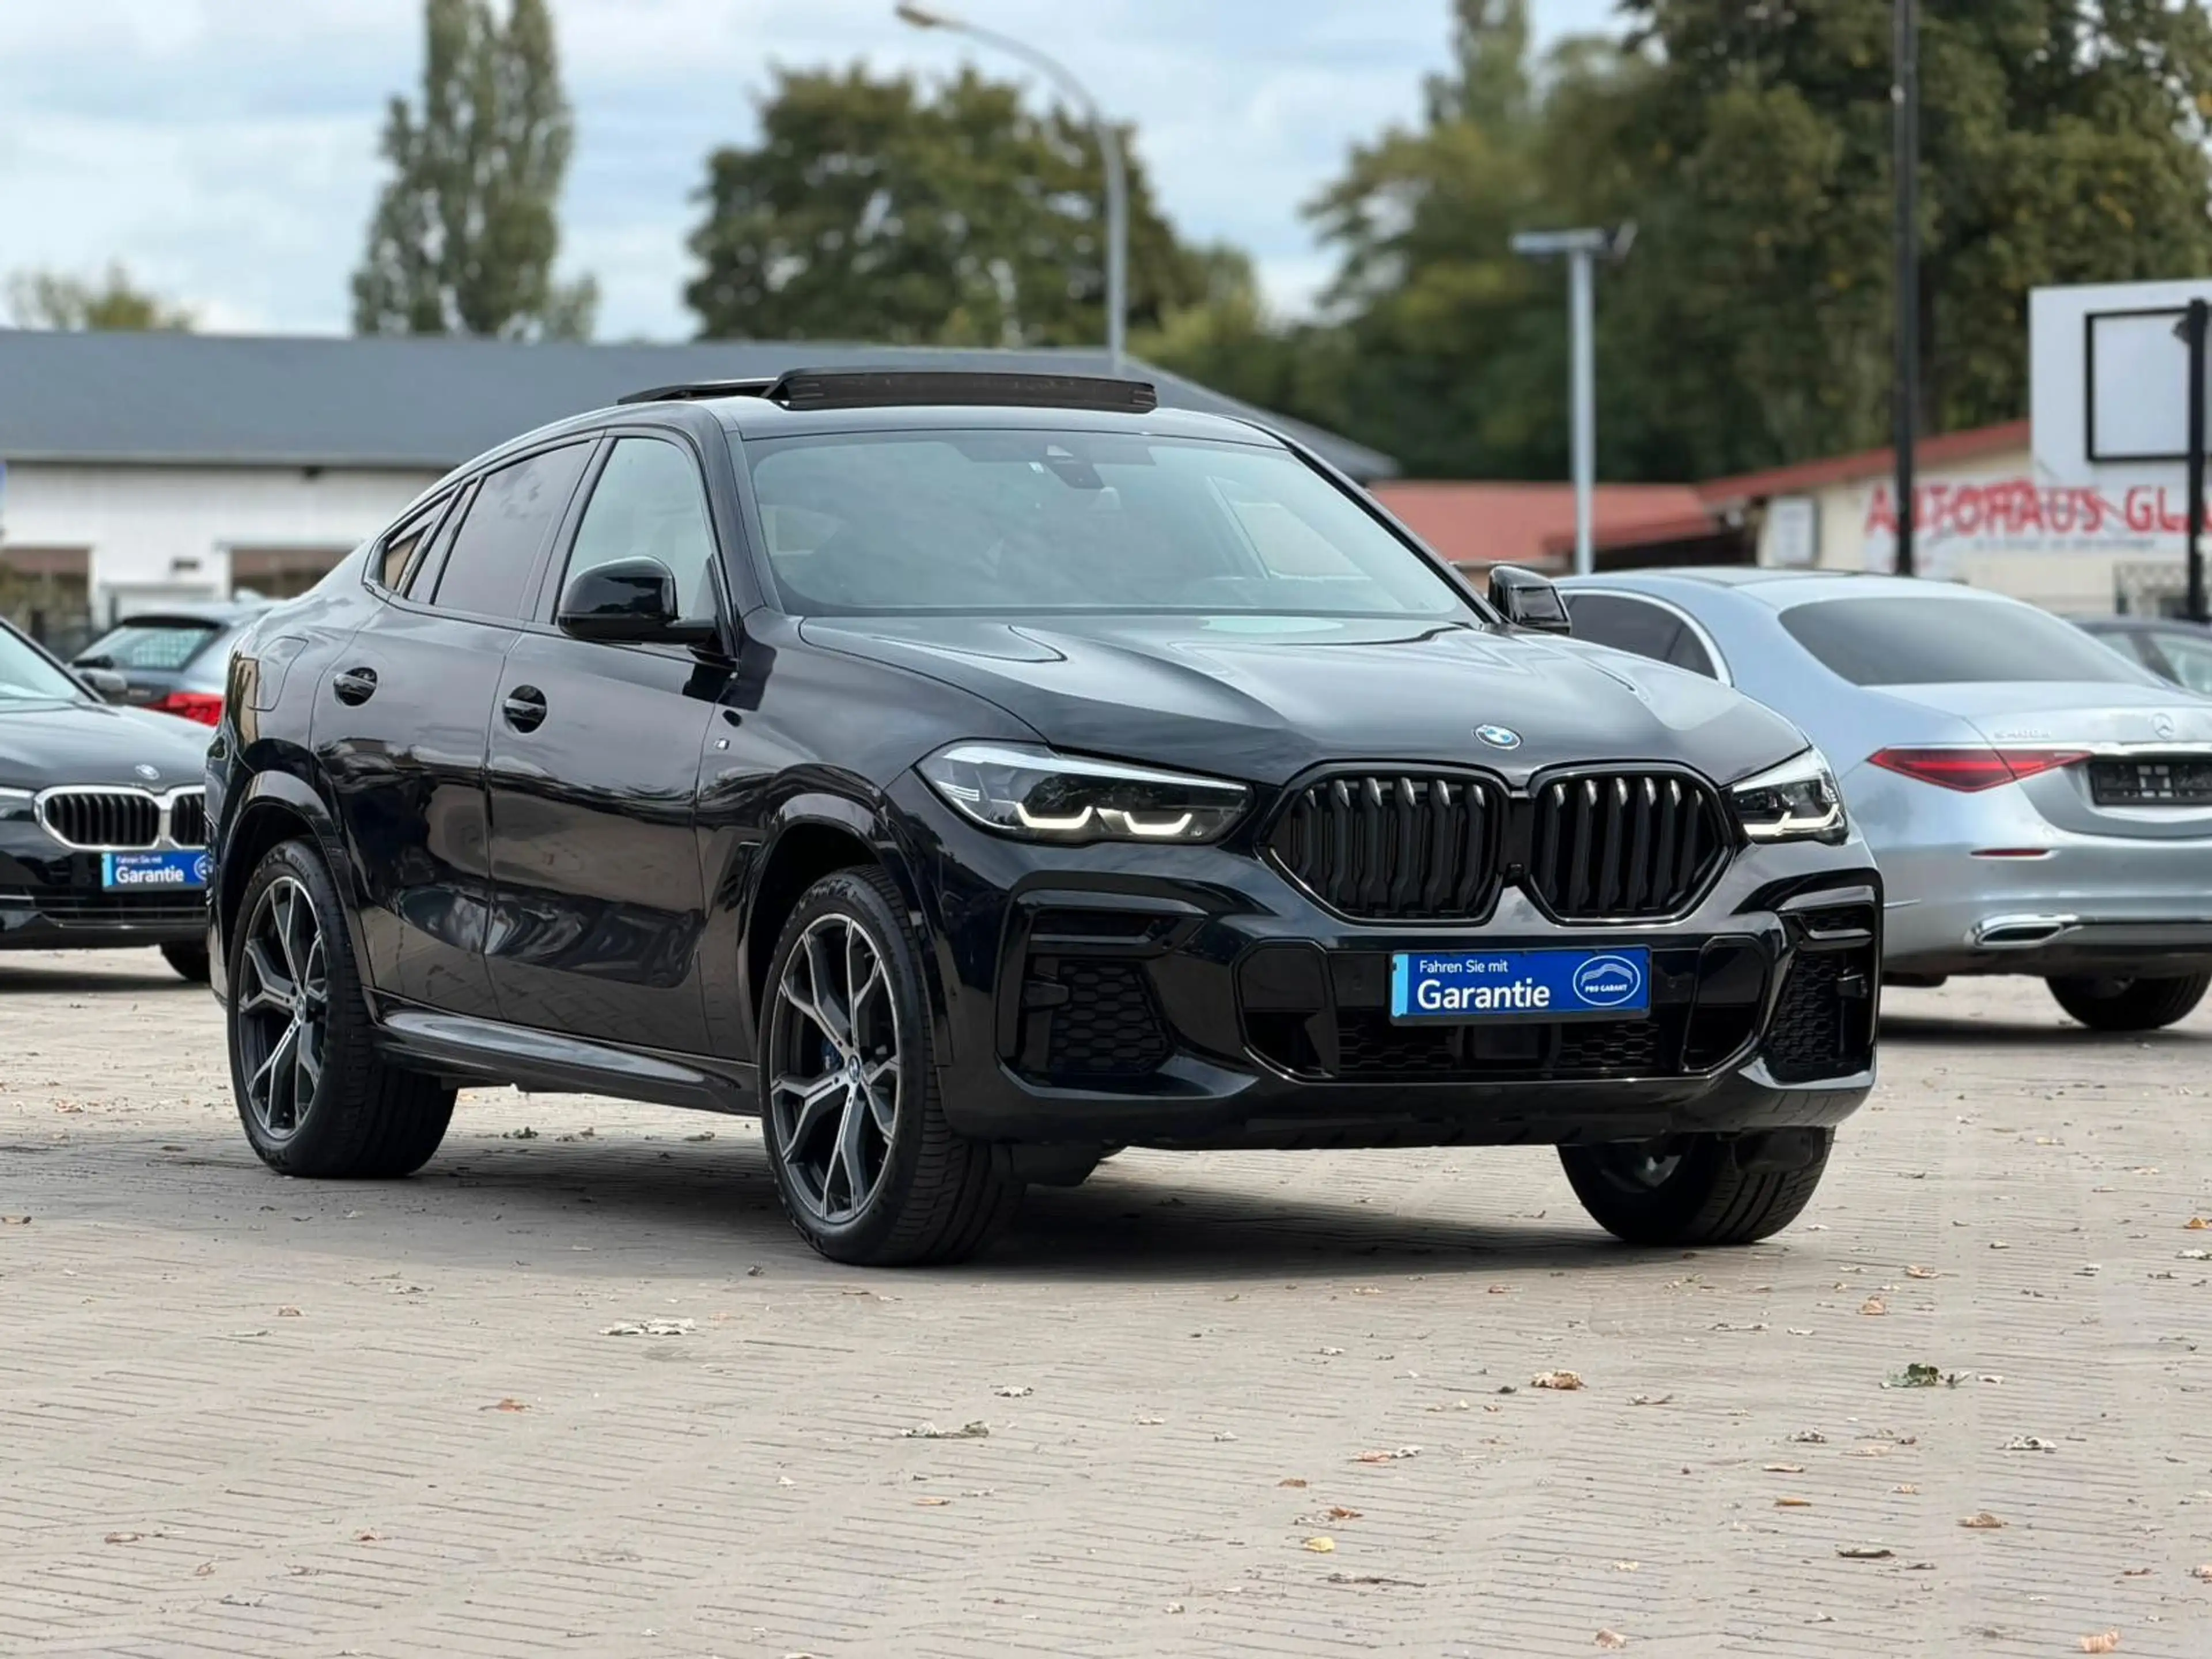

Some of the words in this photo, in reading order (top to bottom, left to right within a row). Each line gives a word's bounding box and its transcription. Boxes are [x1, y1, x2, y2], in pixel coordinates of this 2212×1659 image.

[2125, 485, 2212, 535] GL
[116, 865, 184, 884] Garantie
[1419, 959, 1463, 974] Fahren
[1465, 959, 1485, 973] Sie
[1488, 958, 1509, 973] mit
[1417, 978, 1550, 1009] Garantie
